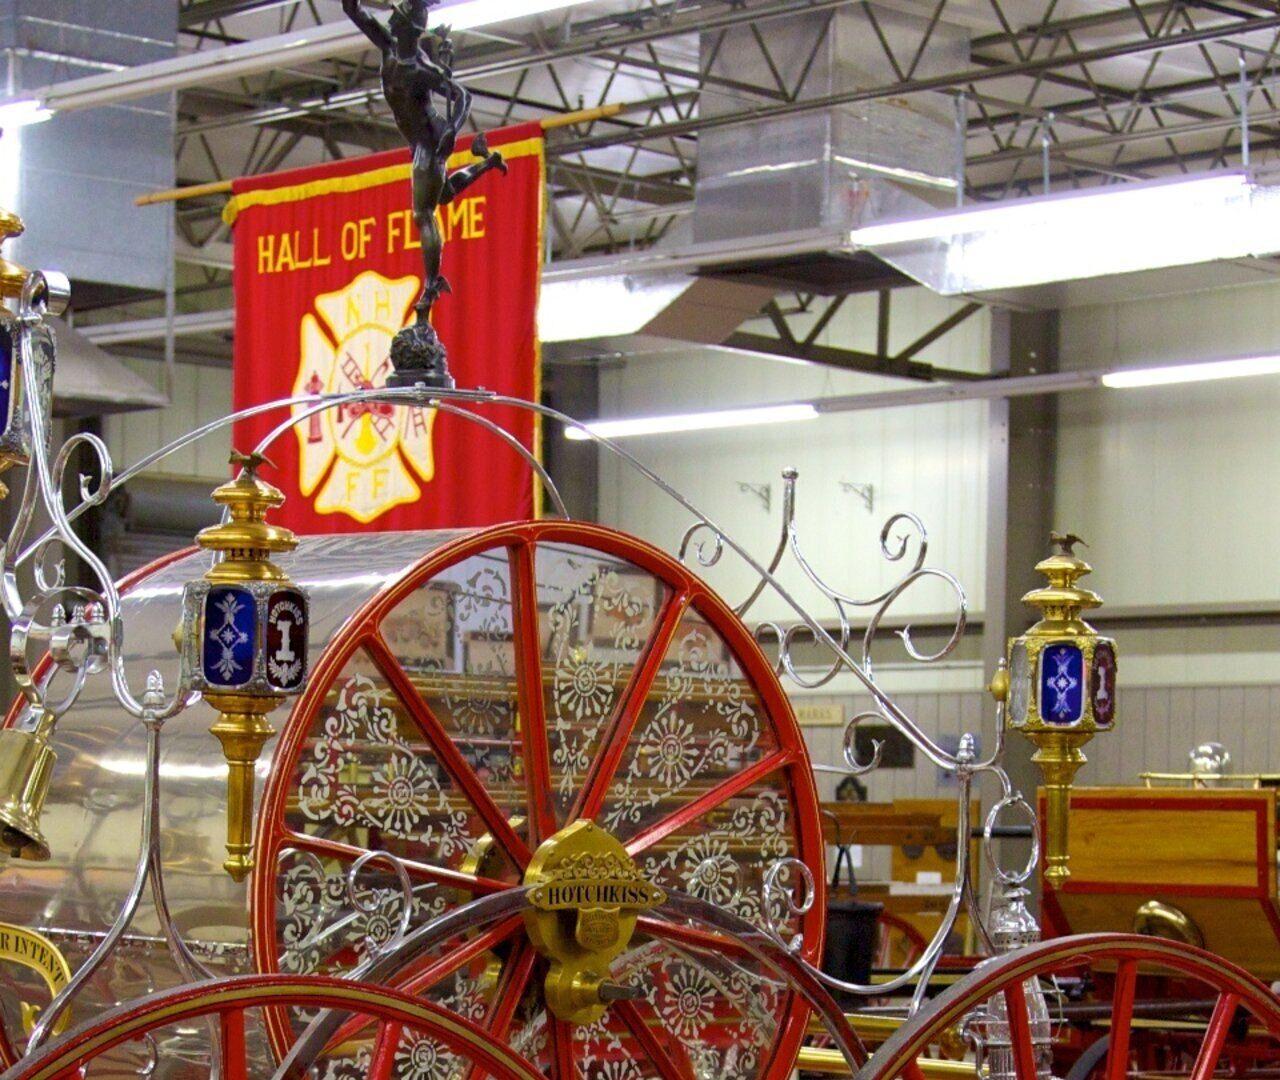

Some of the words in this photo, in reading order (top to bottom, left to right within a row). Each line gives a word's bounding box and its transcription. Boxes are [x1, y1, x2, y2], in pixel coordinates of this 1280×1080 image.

[258, 227, 332, 274] HALL
[341, 216, 376, 261] OF
[269, 600, 304, 626] HOTCHKISS
[275, 620, 296, 661] 1
[548, 884, 650, 905] HOTCHKISS
[14, 935, 65, 985] INTENT
